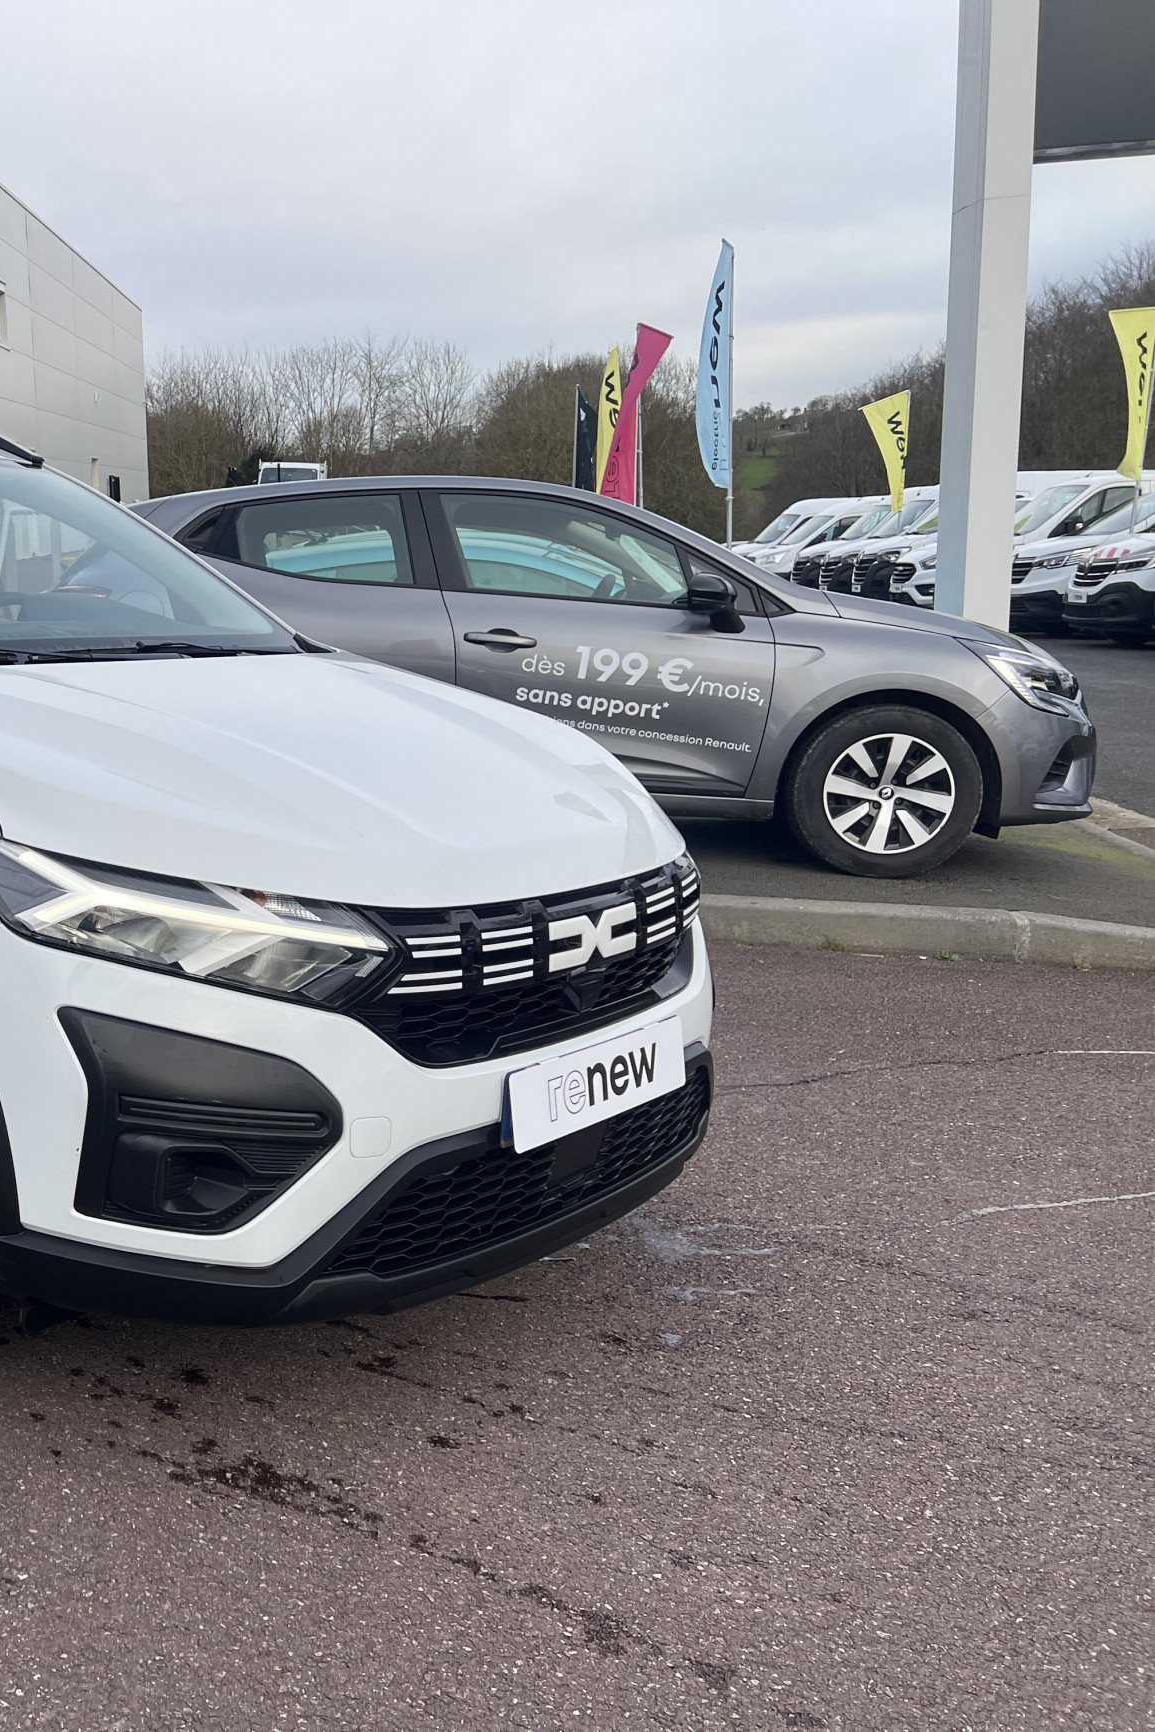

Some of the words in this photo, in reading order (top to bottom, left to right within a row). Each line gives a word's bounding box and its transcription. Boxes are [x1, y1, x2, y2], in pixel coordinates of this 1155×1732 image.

[521, 654, 566, 676] dès
[576, 645, 650, 686] 199
[515, 685, 572, 707] sans
[577, 719, 606, 732] dans
[607, 725, 637, 737] votre
[638, 729, 703, 746] concession
[704, 737, 752, 752] Renault.
[547, 1042, 657, 1122] renew
